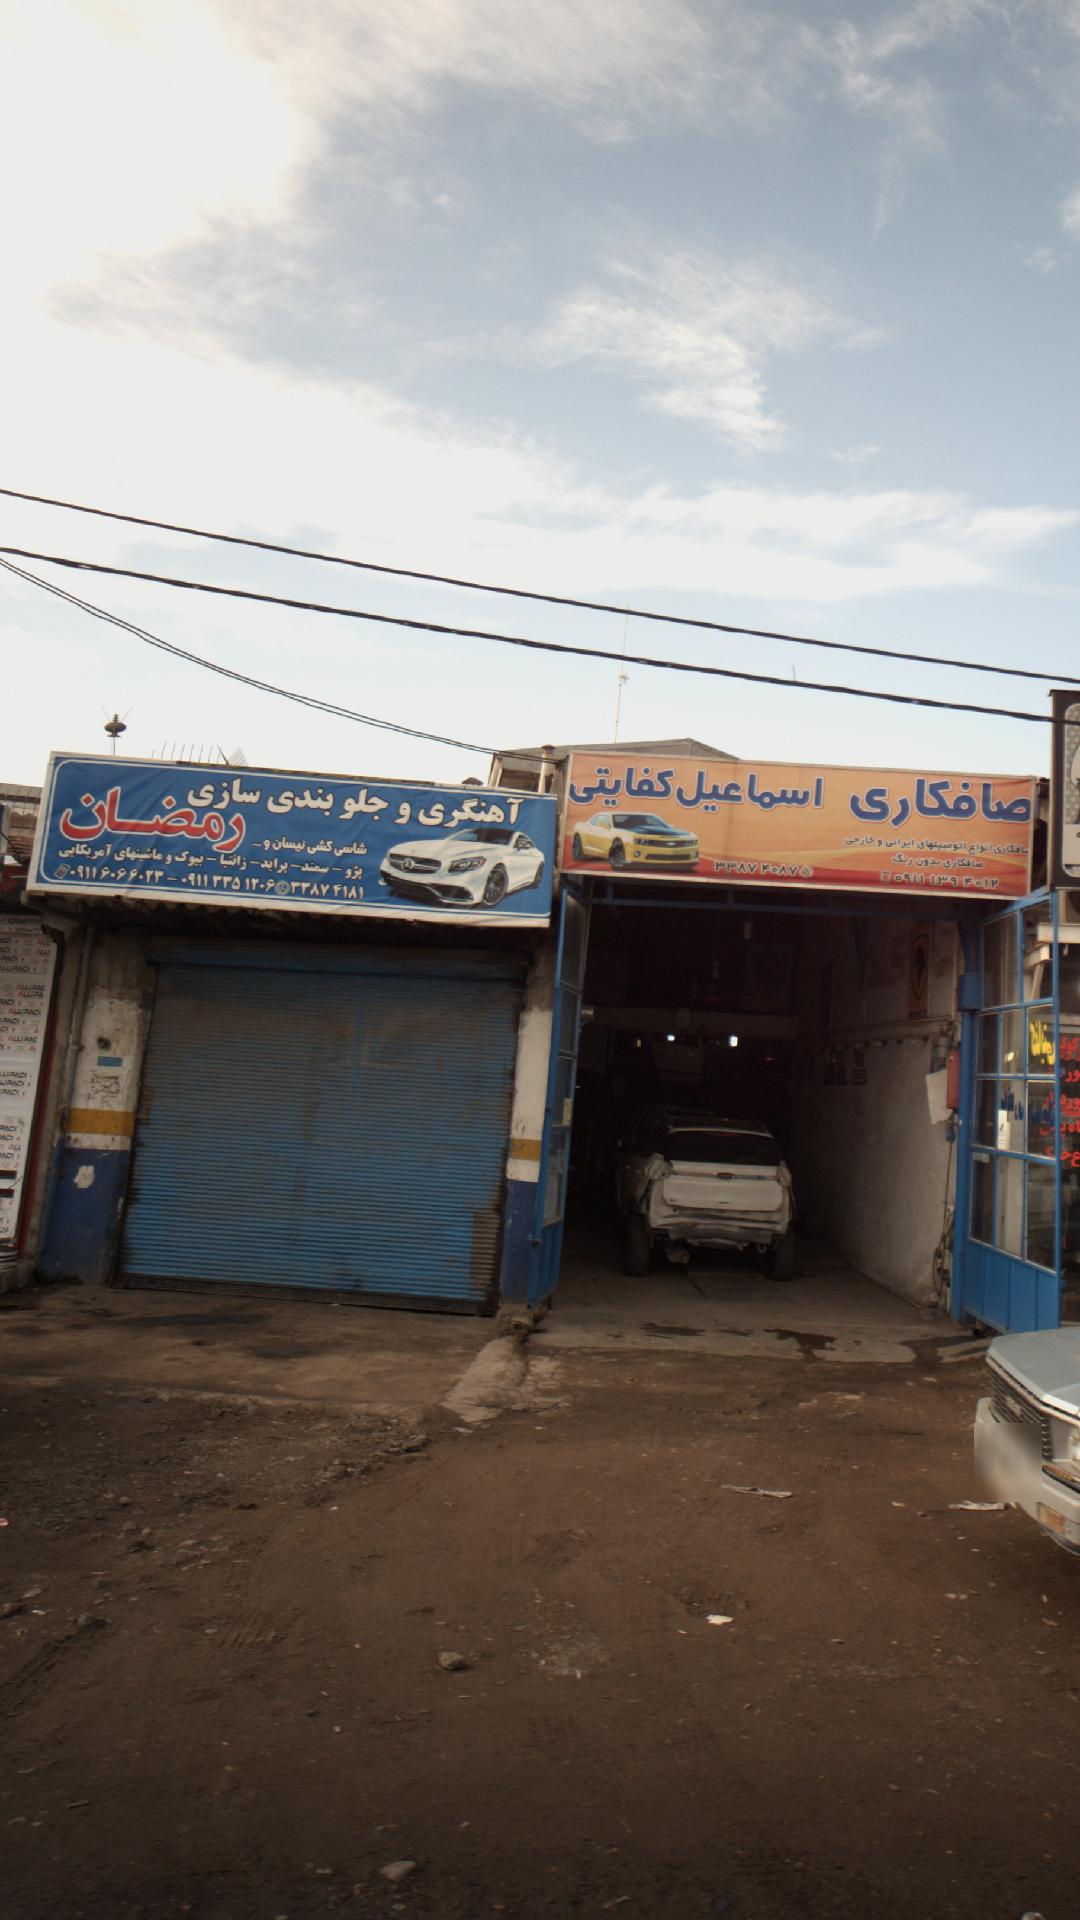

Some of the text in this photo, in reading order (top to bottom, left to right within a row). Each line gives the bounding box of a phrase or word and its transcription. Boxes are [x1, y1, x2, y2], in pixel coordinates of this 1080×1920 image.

[187, 778, 524, 829] آهنگری و جلو بندی سازی
[568, 766, 1031, 829] صافکاری اسماعیل کفایتی
[60, 786, 246, 853] رمضان
[263, 840, 270, 851] و
[272, 837, 306, 852] نیسان
[306, 840, 333, 854] کشی
[333, 842, 368, 856] شاسی
[885, 839, 915, 849] ایرانی
[968, 845, 993, 856] انواع
[113, 847, 163, 861] ماشینهای
[165, 853, 172, 864] و
[174, 850, 204, 866] بیوک
[892, 854, 985, 869] صافکاری بدون رنگ
[219, 854, 247, 870] زانتیا
[260, 857, 288, 874] پراید
[301, 862, 330, 873] سمند
[714, 860, 799, 876] ۳۳۸۷ ۴۰۸۷
[344, 864, 363, 879] پژو
[69, 865, 97, 879] ۰۹۱۱
[99, 866, 128, 880] ۶۰۶
[181, 872, 208, 887] ۰۹۱۱
[245, 878, 275, 892] ۱۲۰۶
[290, 881, 329, 896] ۳۳۸۷
[333, 884, 365, 899] ۴۱۸۱
[894, 872, 925, 885] ۰۹۱۱
[929, 874, 958, 888] ۱۳۹
